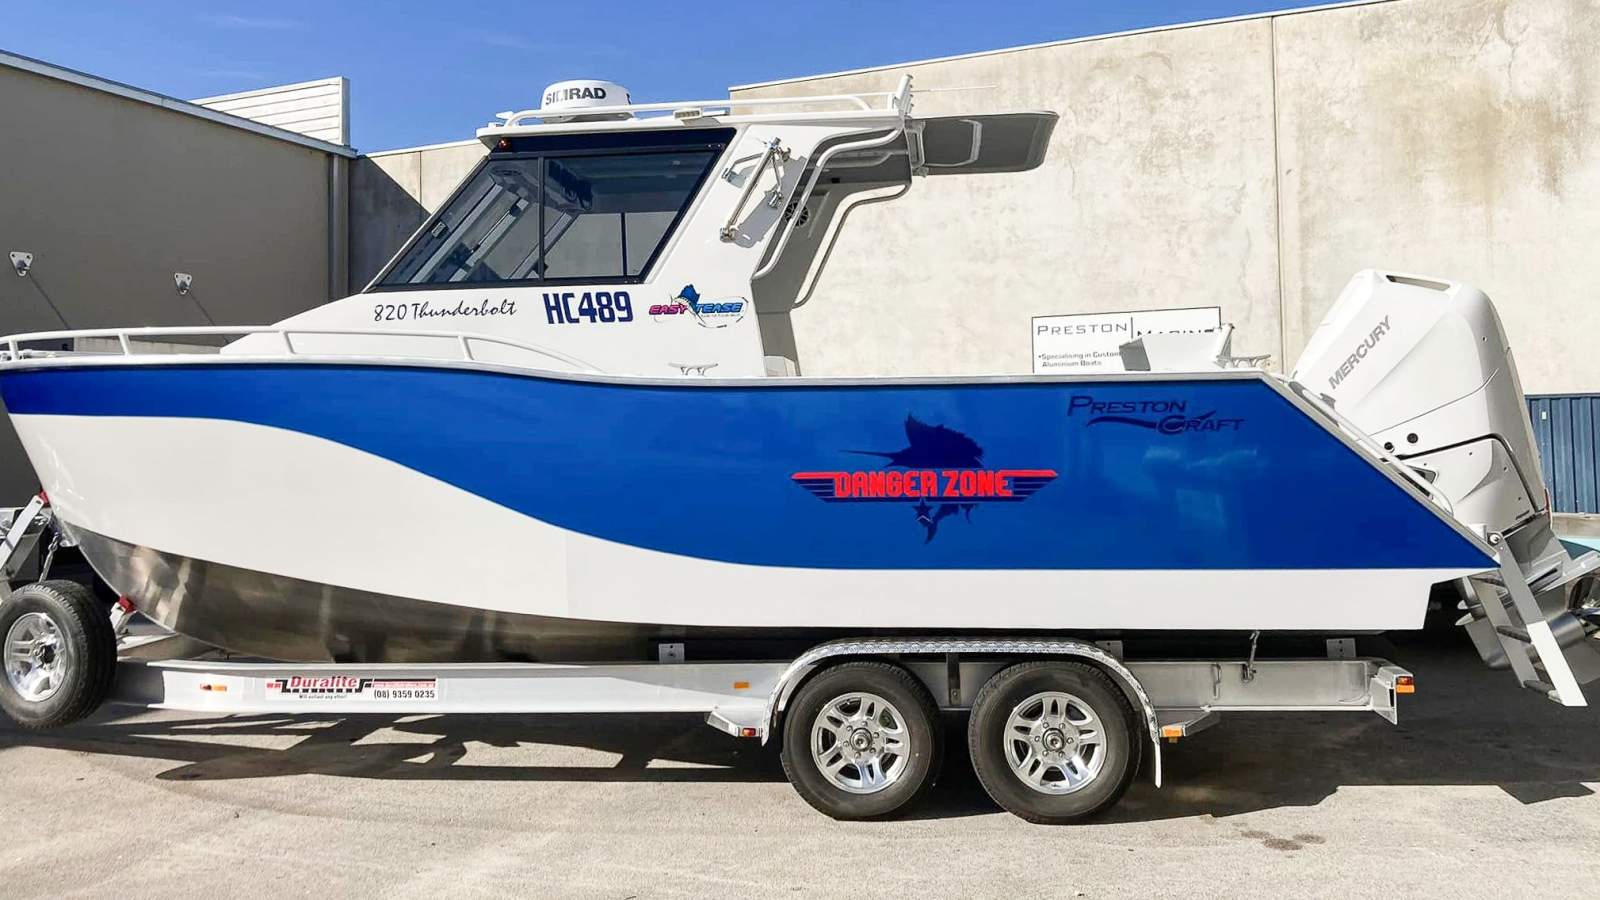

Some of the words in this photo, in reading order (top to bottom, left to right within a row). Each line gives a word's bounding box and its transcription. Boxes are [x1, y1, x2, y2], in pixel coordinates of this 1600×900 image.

[374, 303, 407, 321] 820
[412, 298, 518, 320] Thunderbolt
[542, 291, 634, 324] HC489
[649, 304, 688, 315] EASY
[696, 302, 743, 314] TEASE
[1037, 323, 1128, 336] PRESTON
[1328, 314, 1390, 389] MERCURY
[1042, 360, 1079, 368] Aluminium
[1067, 396, 1187, 416] PRESTON
[1158, 412, 1245, 435] CRAFT
[833, 470, 938, 498] DANGER
[942, 470, 1013, 497] ZONE
[290, 676, 357, 688] Duralite
[374, 689, 389, 699] (08)
[393, 689, 412, 698] 9359
[415, 689, 435, 698] 0235
